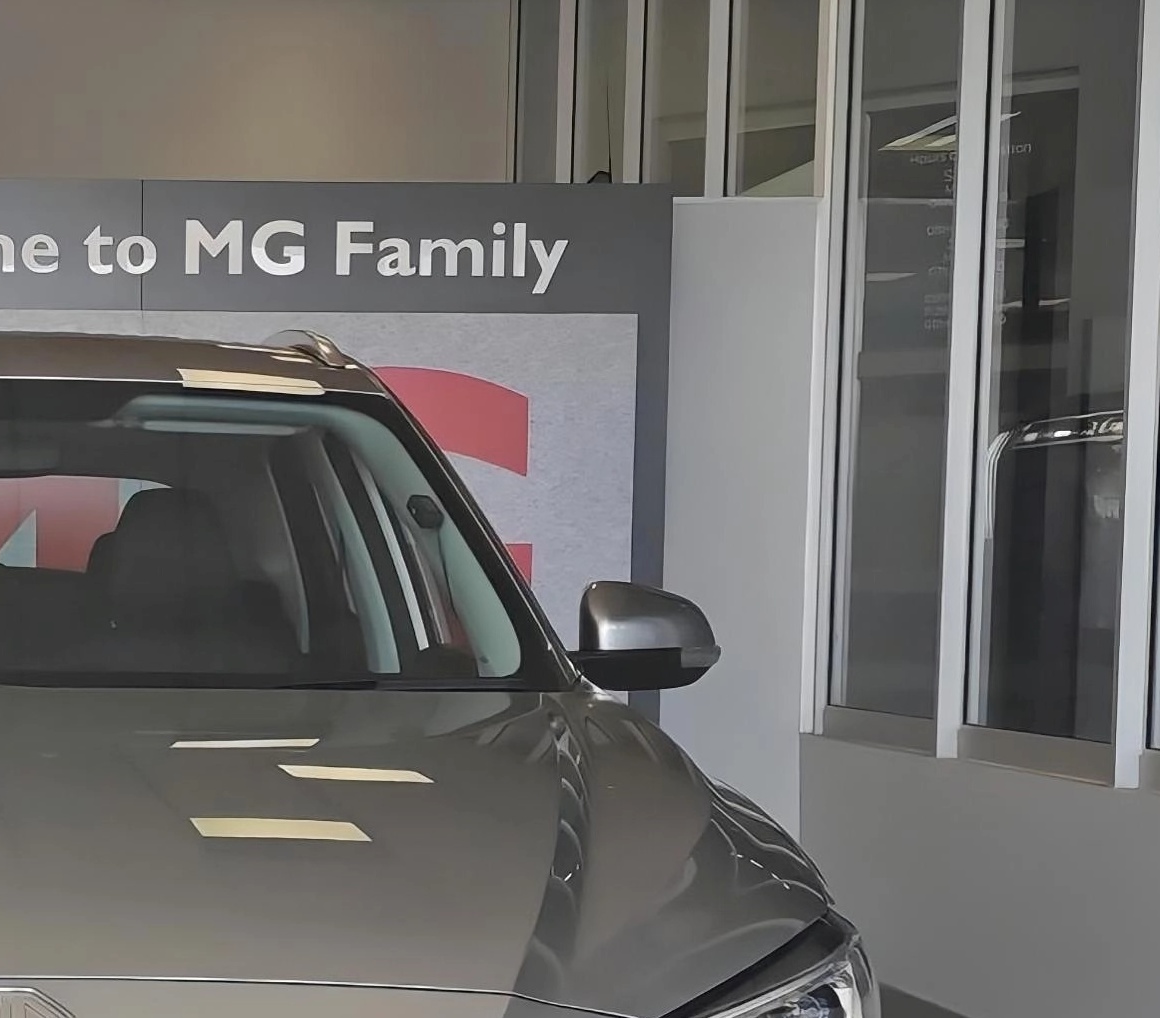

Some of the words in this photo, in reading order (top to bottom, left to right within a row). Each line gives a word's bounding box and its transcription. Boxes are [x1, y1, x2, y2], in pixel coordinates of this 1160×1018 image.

[82, 224, 158, 275] to
[184, 218, 306, 277] MG
[335, 221, 570, 295] Family
